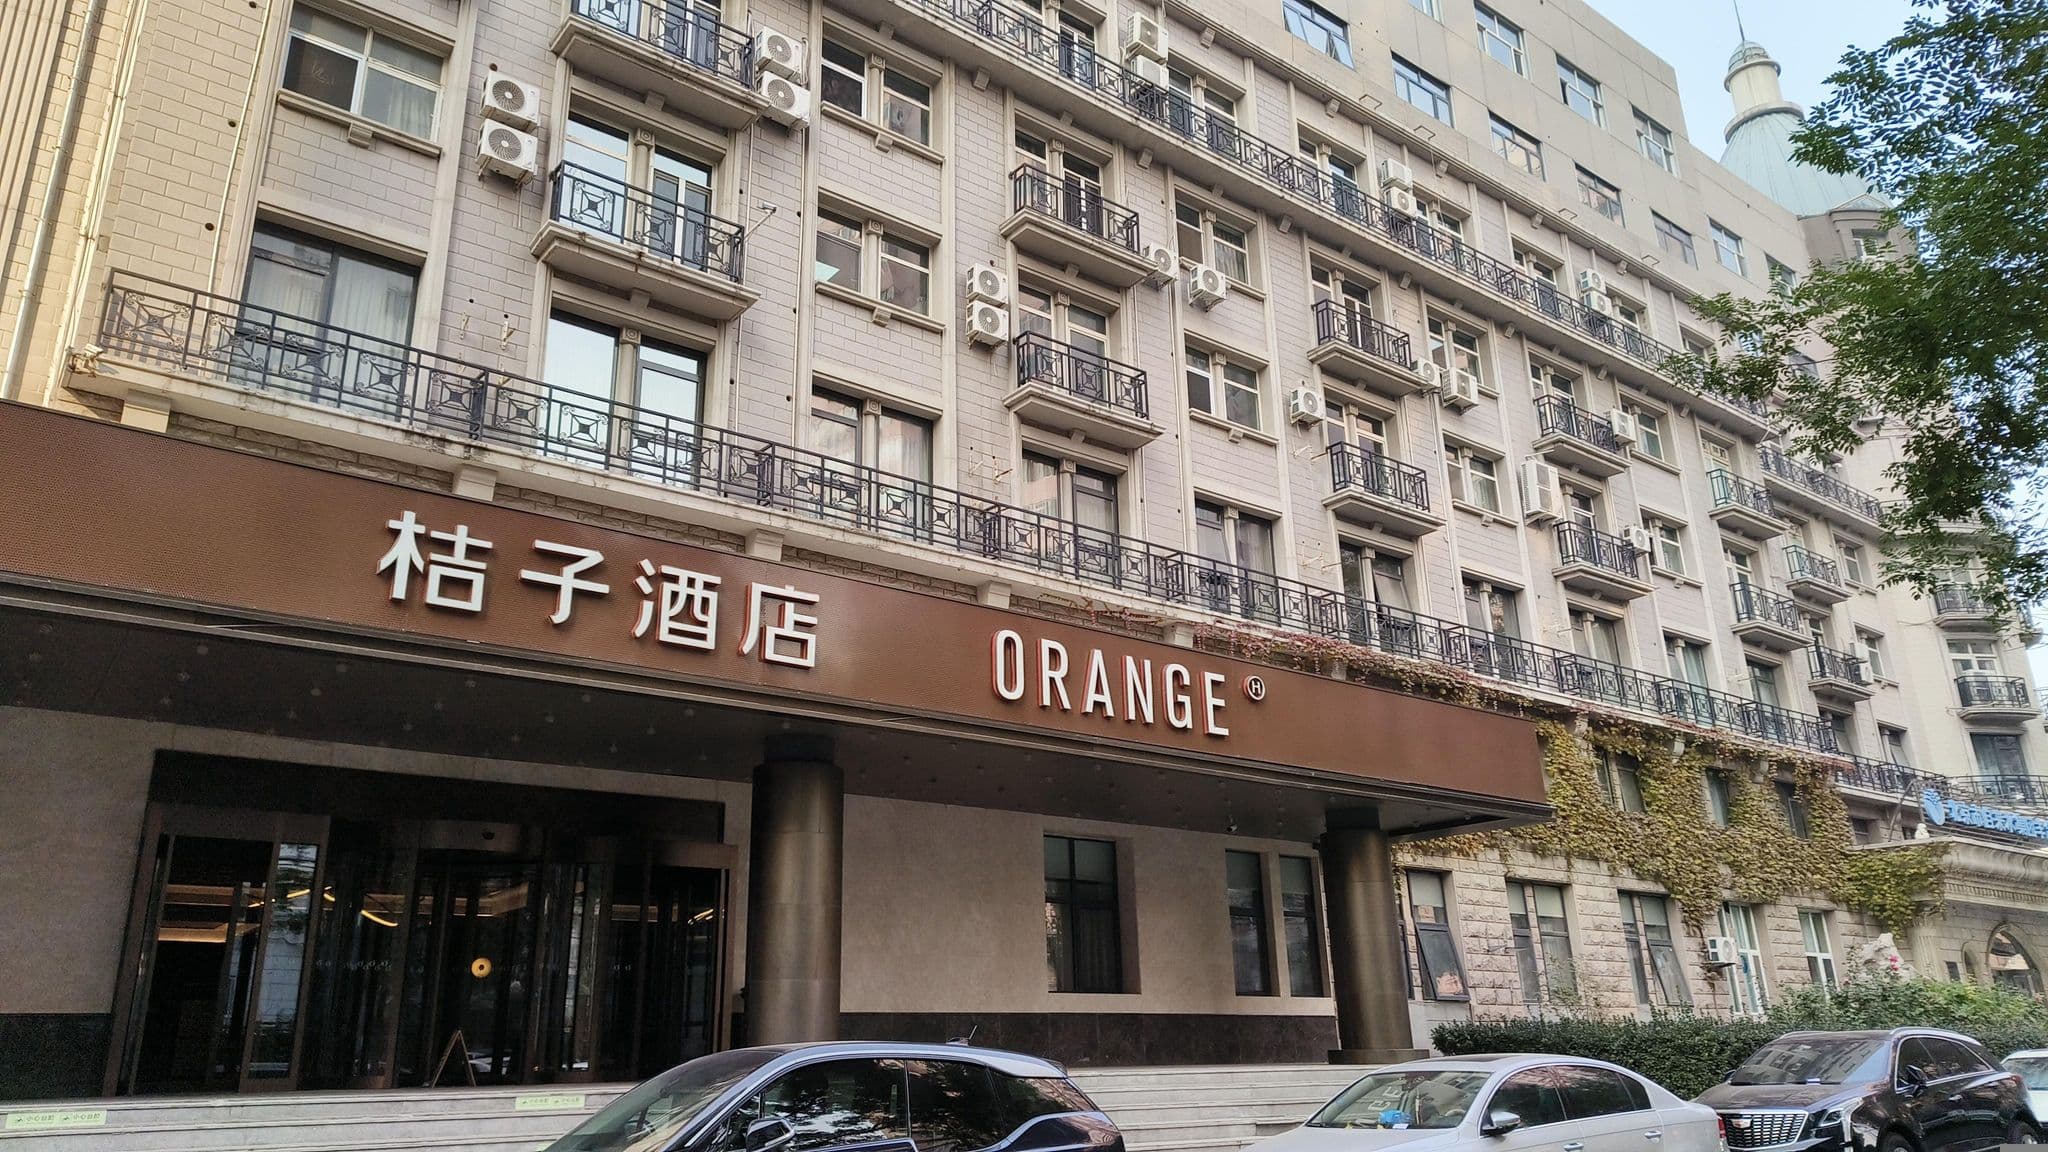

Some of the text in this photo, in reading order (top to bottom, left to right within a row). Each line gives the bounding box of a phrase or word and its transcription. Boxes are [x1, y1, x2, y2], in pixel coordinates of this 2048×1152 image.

[376, 510, 820, 669] 桔子酒店
[991, 629, 1230, 737] ORANGE
